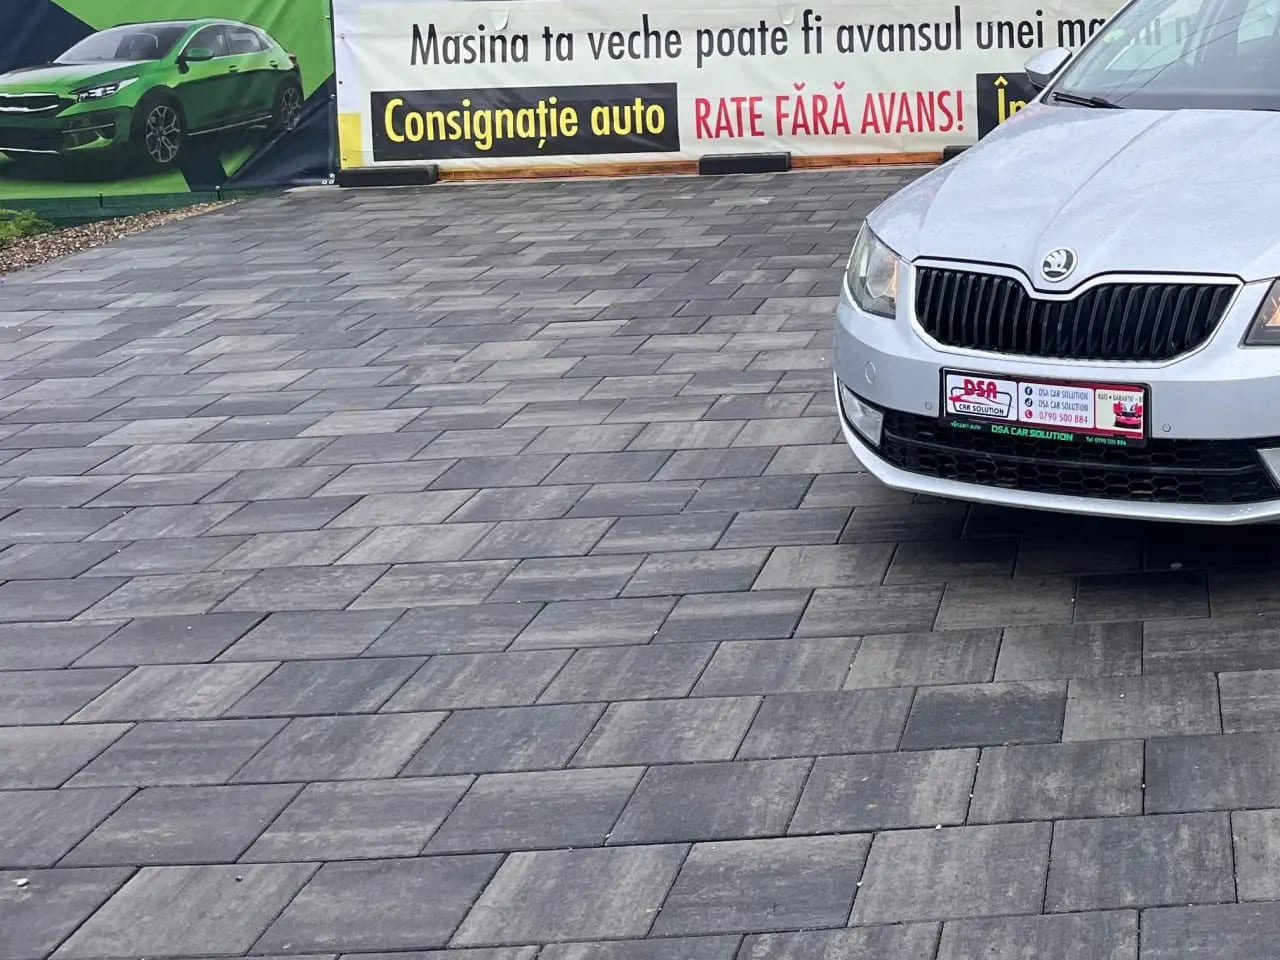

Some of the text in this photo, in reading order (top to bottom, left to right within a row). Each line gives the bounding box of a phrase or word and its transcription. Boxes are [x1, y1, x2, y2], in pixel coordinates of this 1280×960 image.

[410, 23, 529, 66] Masina
[542, 25, 574, 62] ta
[587, 13, 683, 60] veche
[696, 20, 789, 69] poate
[801, 9, 823, 54] fi
[836, 5, 962, 54] avansul
[976, 9, 1044, 50] unei
[694, 80, 965, 139] RATE FĂRĂ AVANS!
[384, 96, 666, 151] Consignație auto
[964, 378, 998, 400] DSA
[1038, 388, 1089, 400] DSA CAR SOLUTION
[958, 403, 1004, 415] CAR SOLUTION
[1038, 399, 1089, 412] DSA CAR SOLUTION
[1039, 411, 1088, 424] 0790 500 884
[990, 424, 1075, 441] DSA CAR SOLUTION
